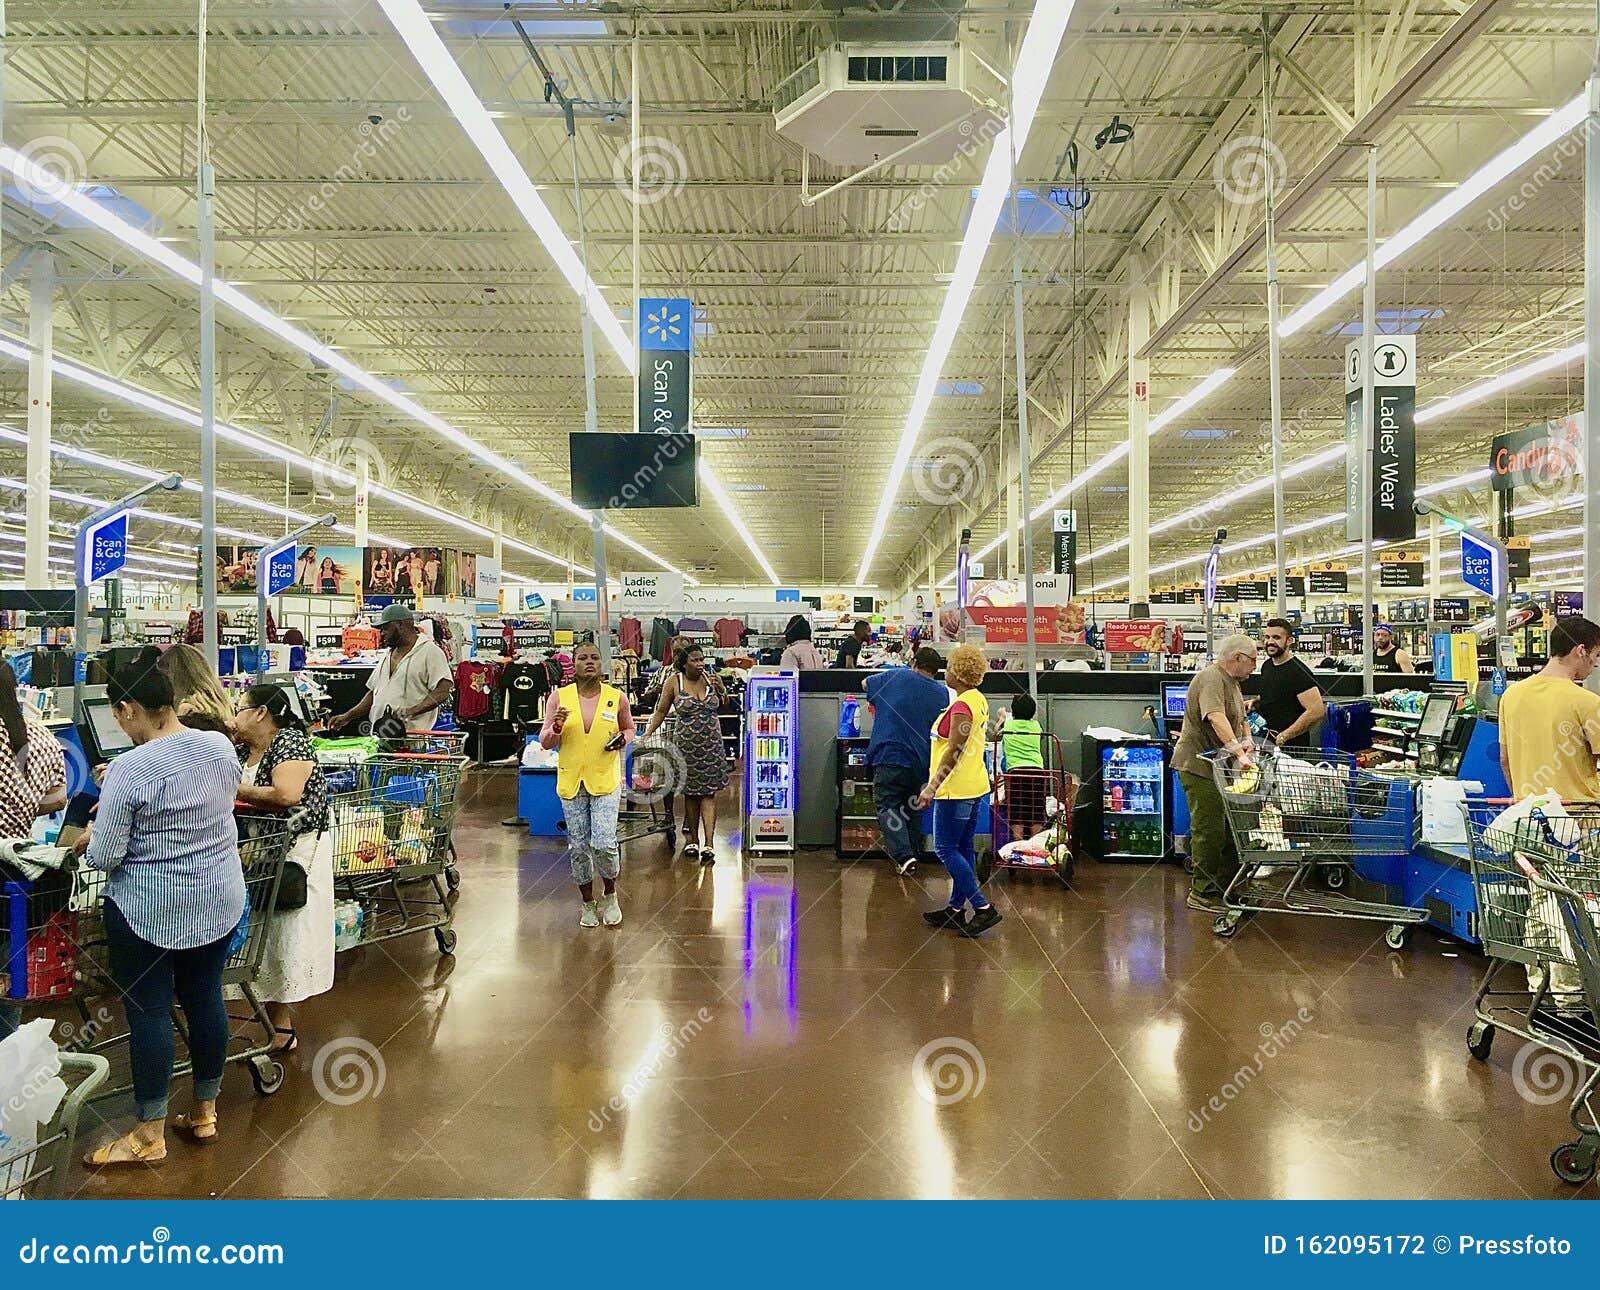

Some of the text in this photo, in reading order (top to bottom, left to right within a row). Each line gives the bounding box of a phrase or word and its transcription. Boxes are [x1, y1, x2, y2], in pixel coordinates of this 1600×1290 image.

[653, 359, 673, 423] Scan &
[1380, 396, 1400, 510] Ladies' Wear
[95, 537, 122, 548] Scan
[1061, 535, 1071, 574] Men's We
[271, 561, 293, 570] Scan
[1465, 556, 1489, 566] Scan
[624, 576, 659, 587] Ladies'
[1035, 579, 1057, 588] onal
[624, 587, 657, 598] Active
[983, 614, 1003, 623] Save
[986, 624, 1024, 636] n-the-go
[1106, 622, 1129, 631] Ready
